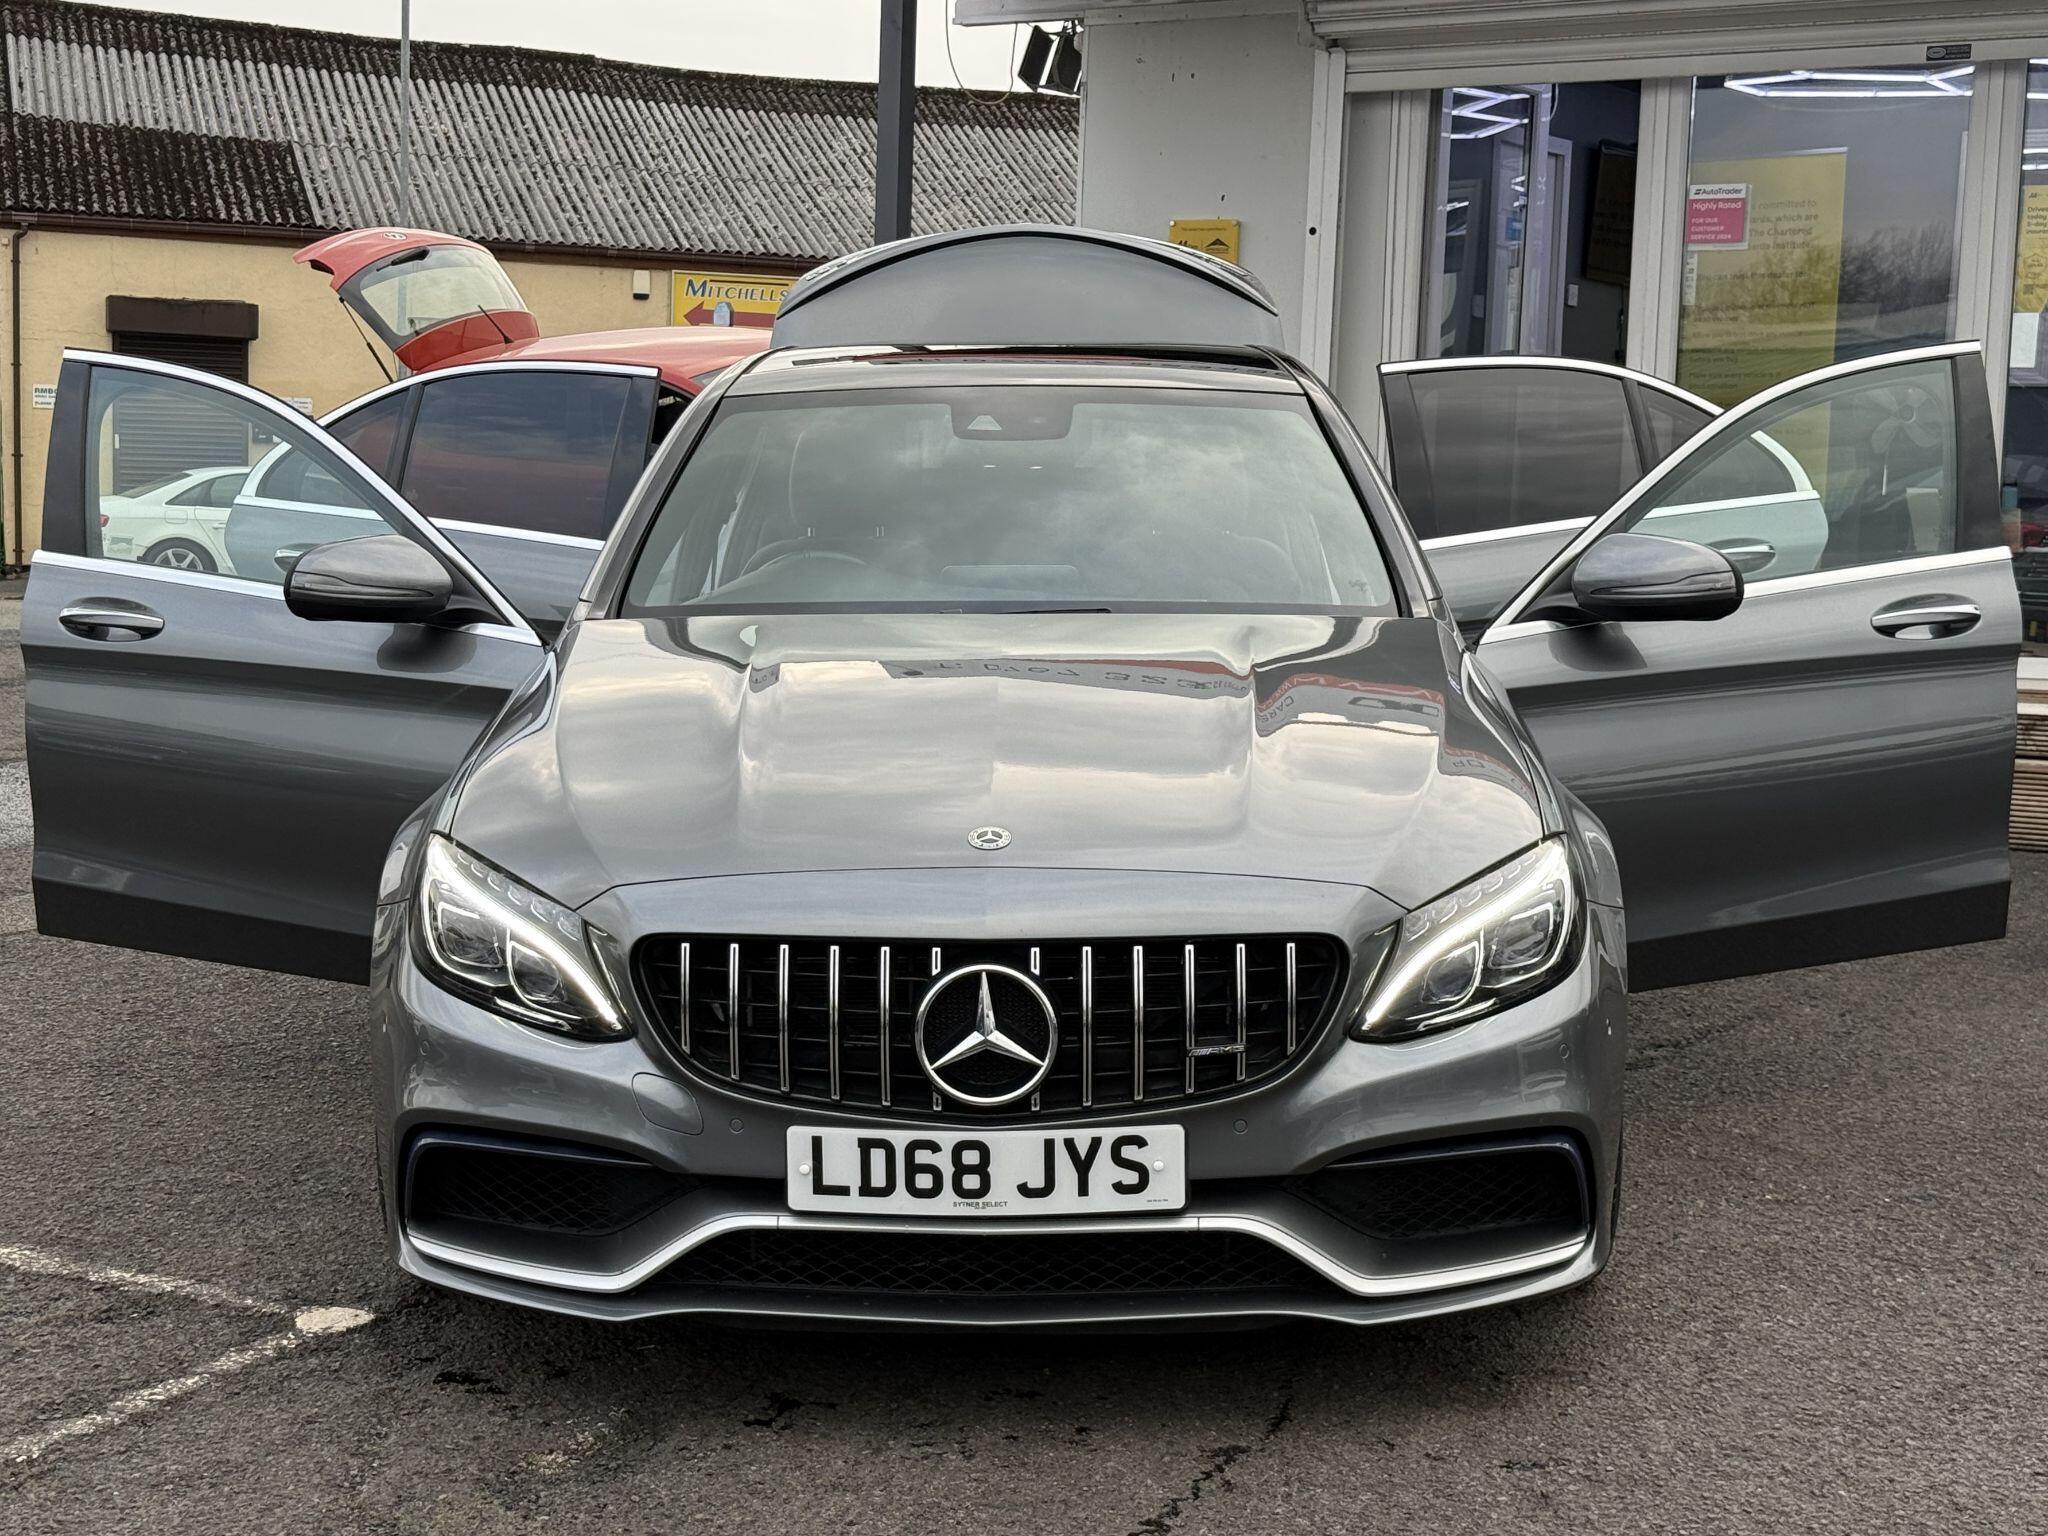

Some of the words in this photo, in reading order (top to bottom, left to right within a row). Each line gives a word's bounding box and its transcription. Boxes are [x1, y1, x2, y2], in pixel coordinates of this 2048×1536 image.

[1702, 187, 1743, 195] AutoTrader
[1692, 201, 1716, 211] Highly
[1718, 201, 1742, 209] Rated
[685, 278, 789, 301] MITCHELLS
[811, 1135, 991, 1200] LD68
[1016, 1134, 1149, 1199] JYS
